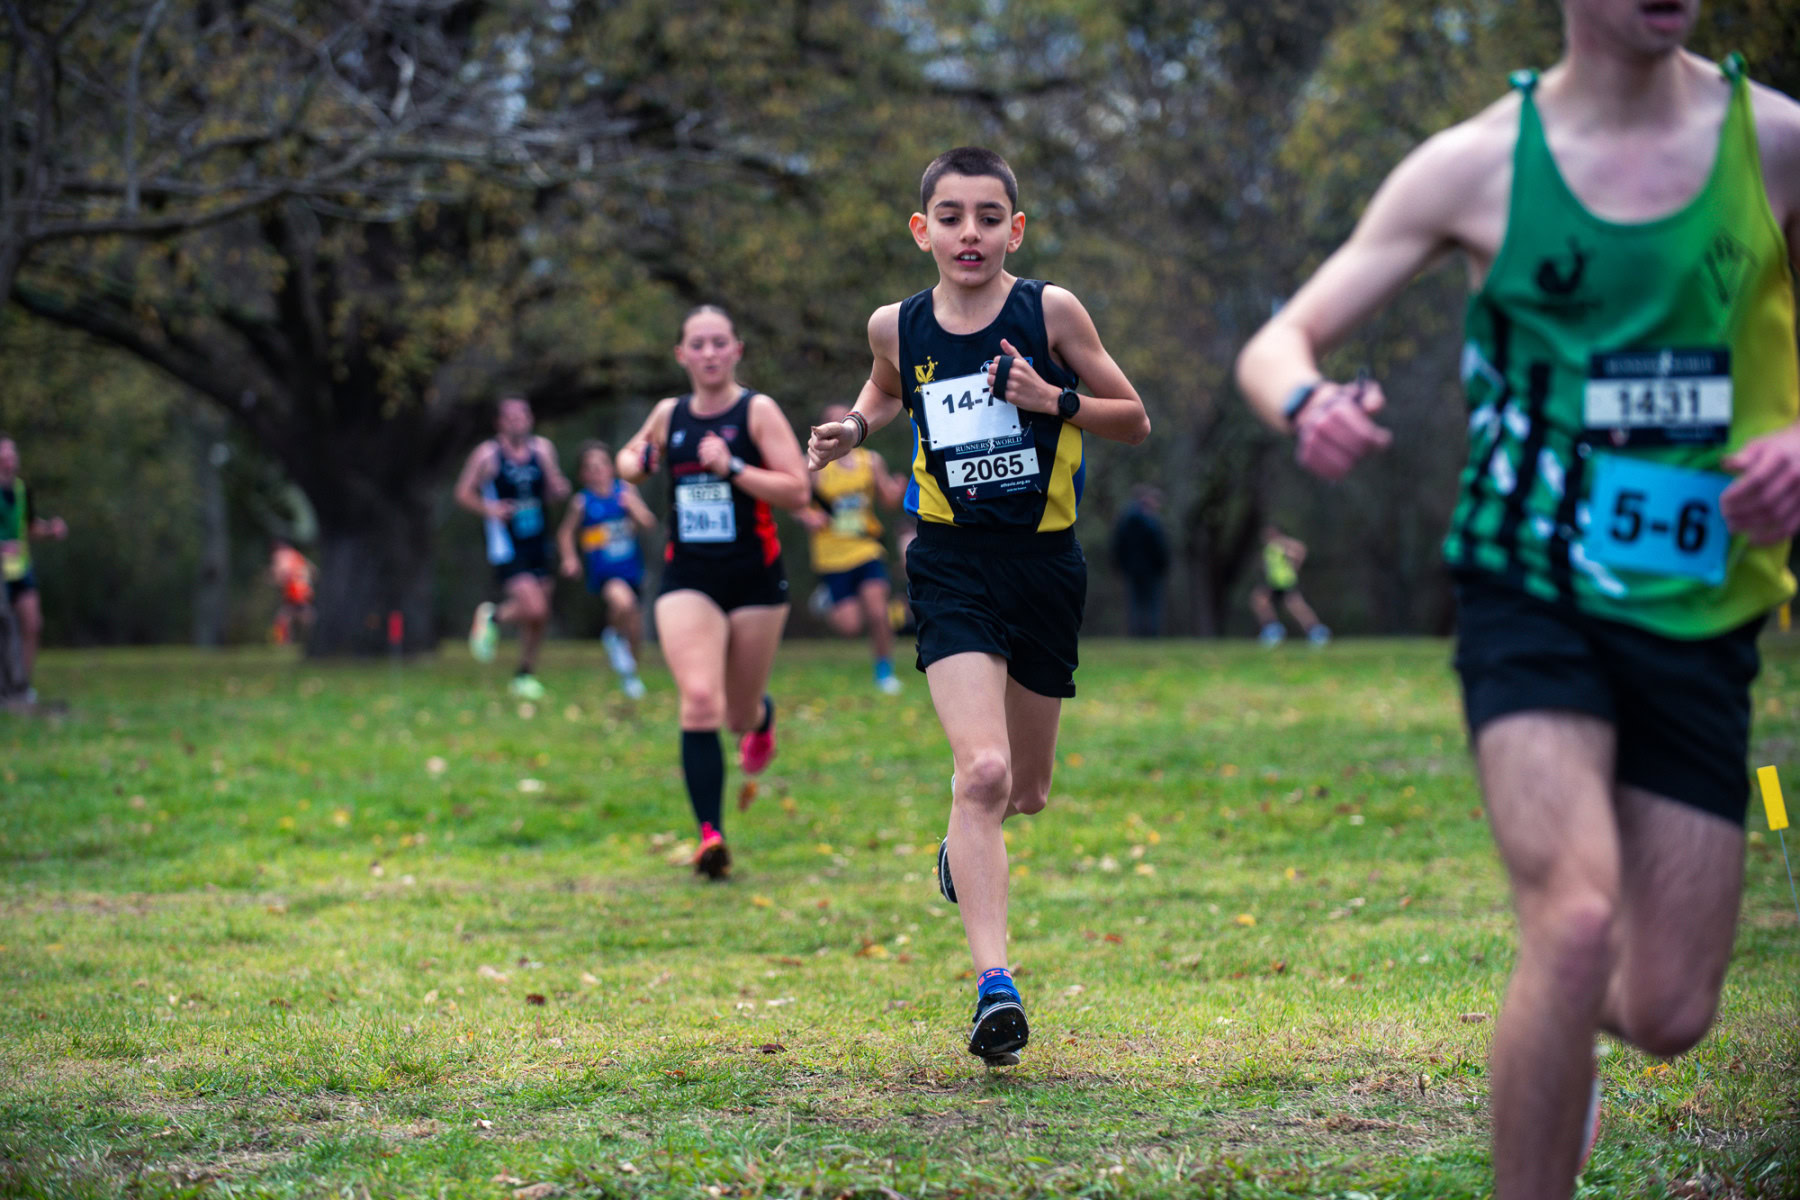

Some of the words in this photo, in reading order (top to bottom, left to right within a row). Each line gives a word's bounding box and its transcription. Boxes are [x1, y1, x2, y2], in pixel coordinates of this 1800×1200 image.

[995, 436, 1023, 446] WORLD
[961, 453, 1024, 483] 2065
[1610, 489, 1711, 555] 5-6
